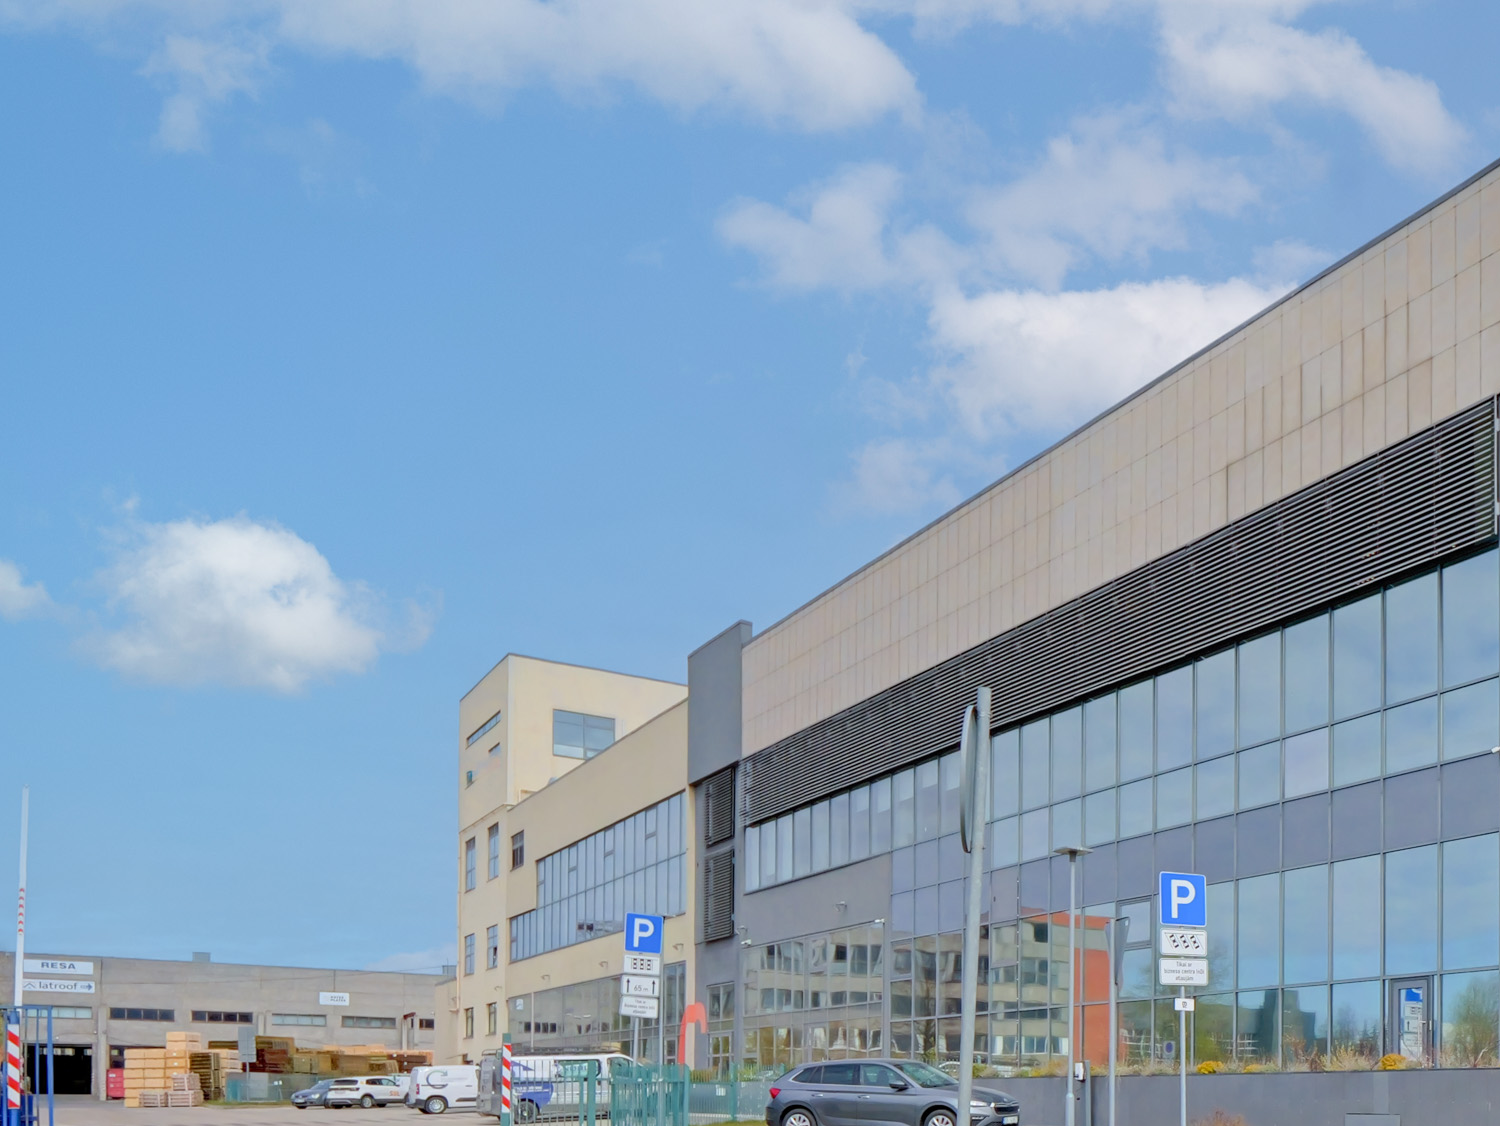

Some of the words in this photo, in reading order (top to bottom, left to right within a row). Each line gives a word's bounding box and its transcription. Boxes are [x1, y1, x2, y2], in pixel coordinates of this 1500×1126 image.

[1171, 879, 1196, 919] P
[633, 917, 655, 948] P
[39, 981, 78, 990] latroof
[633, 984, 643, 992] 65
